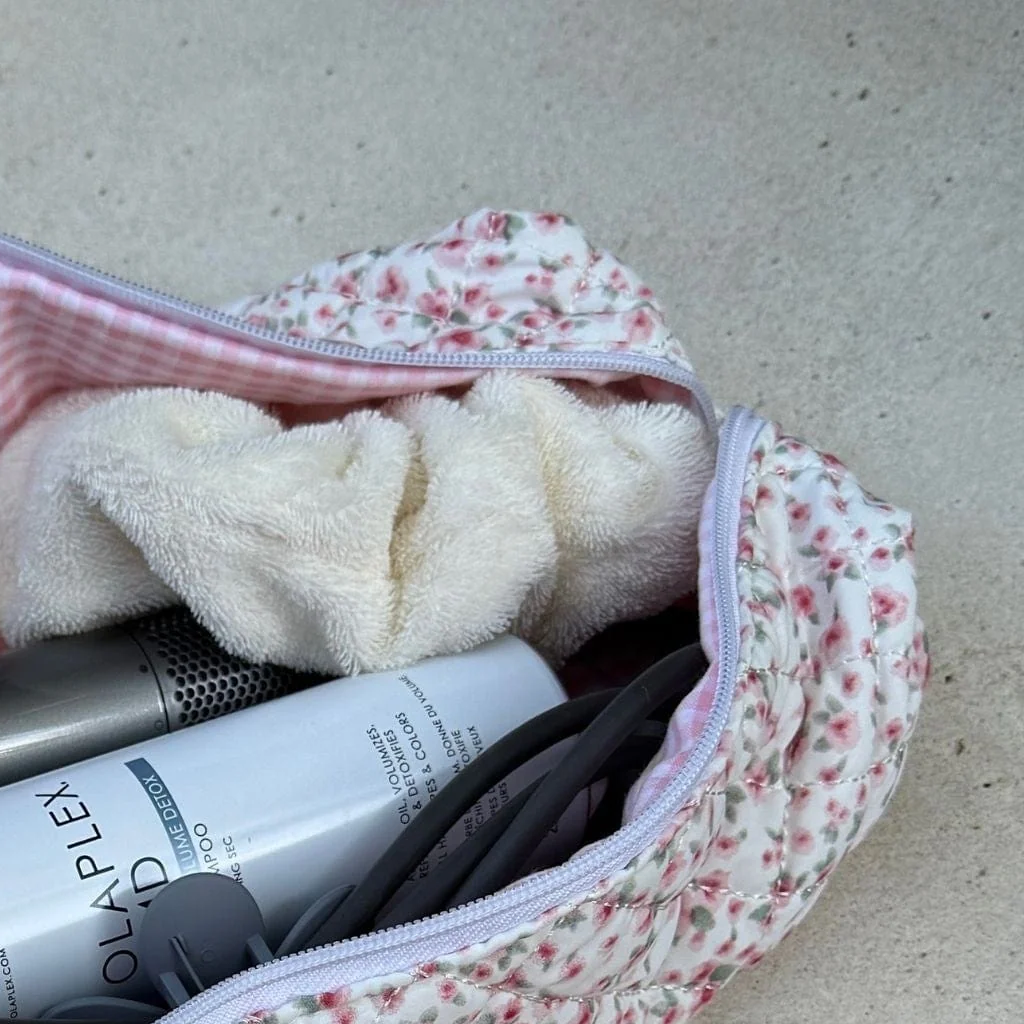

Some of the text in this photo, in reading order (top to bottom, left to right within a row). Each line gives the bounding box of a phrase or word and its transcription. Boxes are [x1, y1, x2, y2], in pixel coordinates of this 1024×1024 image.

[423, 704, 437, 718] DU
[394, 711, 427, 761] COLORS
[432, 719, 456, 758] DONNE
[466, 725, 484, 754] VEUX
[383, 729, 422, 810] & DETOXIFIES
[422, 764, 432, 774] &
[143, 774, 197, 872] LUME DETOX
[222, 835, 238, 859] SEC
[34, 782, 138, 985] OLAPLEX
